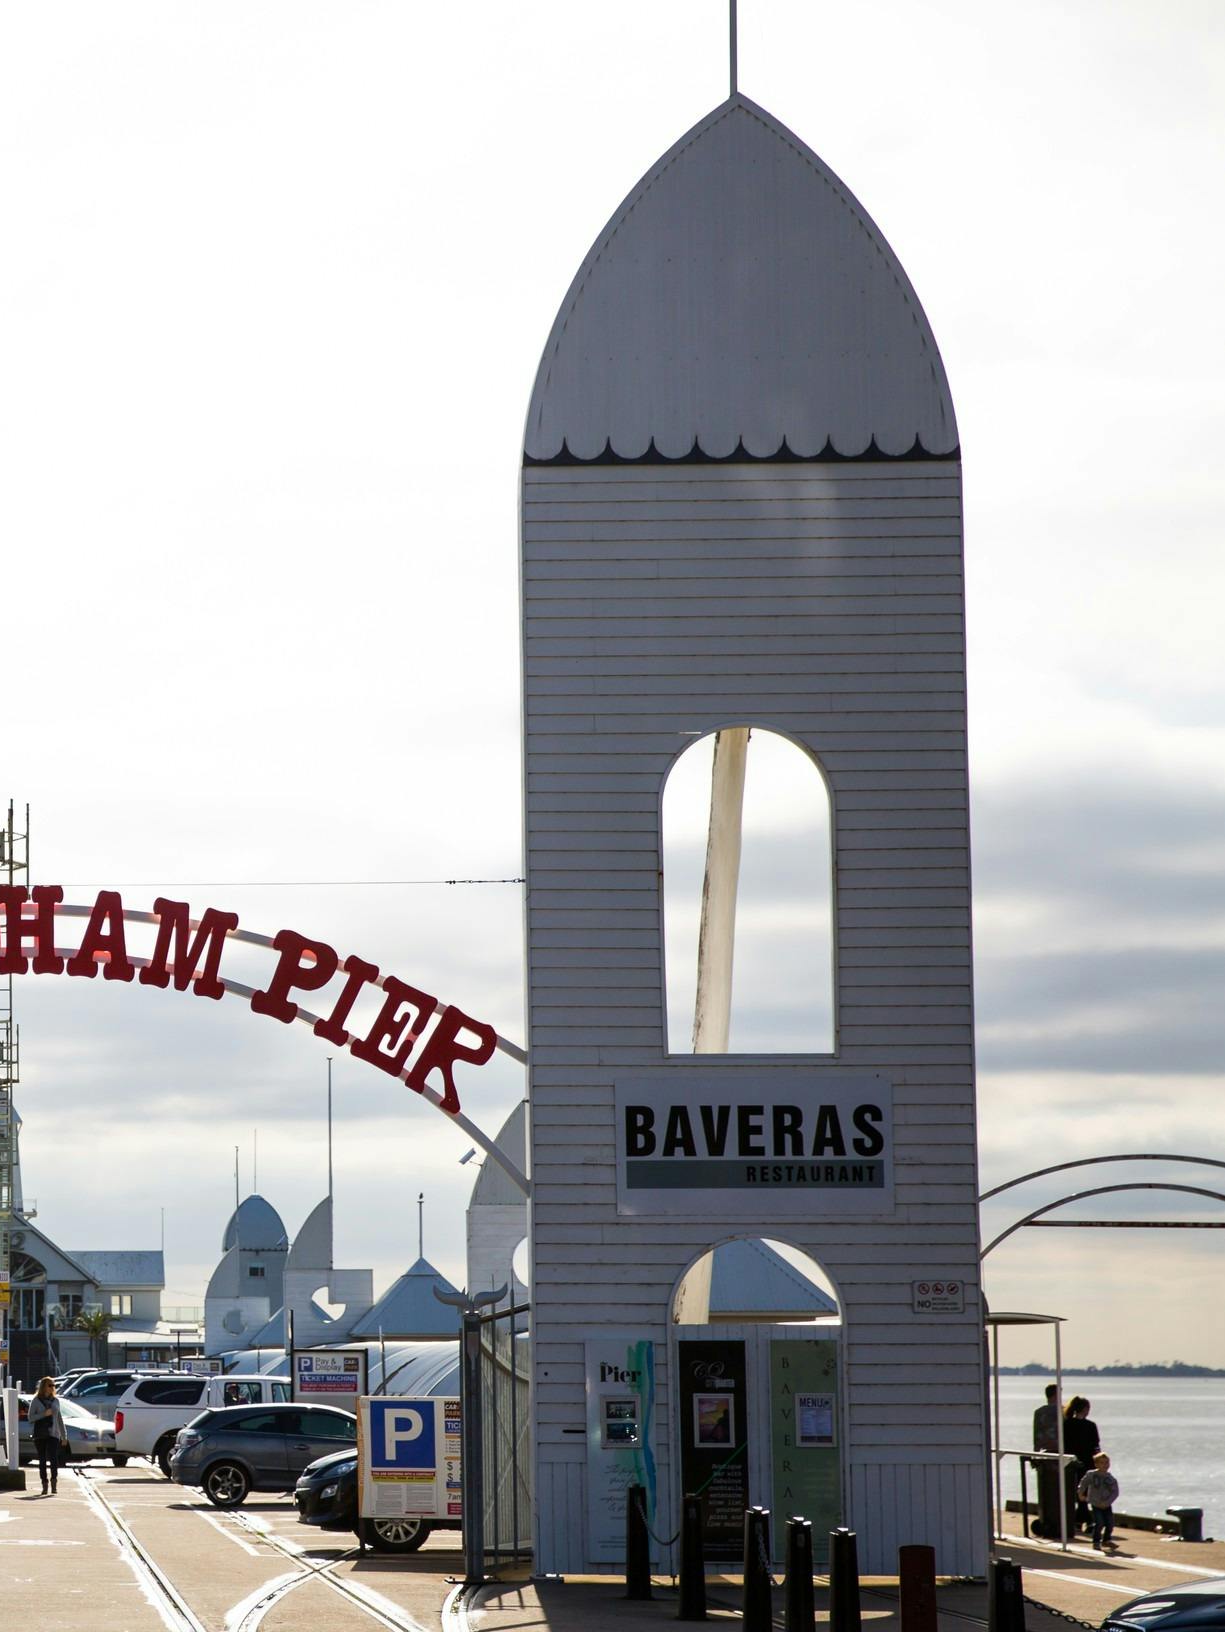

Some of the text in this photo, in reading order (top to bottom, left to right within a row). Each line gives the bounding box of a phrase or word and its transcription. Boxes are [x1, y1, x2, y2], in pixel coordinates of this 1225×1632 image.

[251, 930, 496, 1113] PIER
[625, 1104, 884, 1157] BAVERAS
[746, 1165, 876, 1183] RESTAURANT
[917, 1300, 931, 1308] NO
[300, 1358, 312, 1371] P
[316, 1357, 330, 1367] Pay
[316, 1363, 342, 1372] Display
[600, 1364, 642, 1383] Pier
[799, 1398, 823, 1408] MENU
[384, 1408, 423, 1460] P
